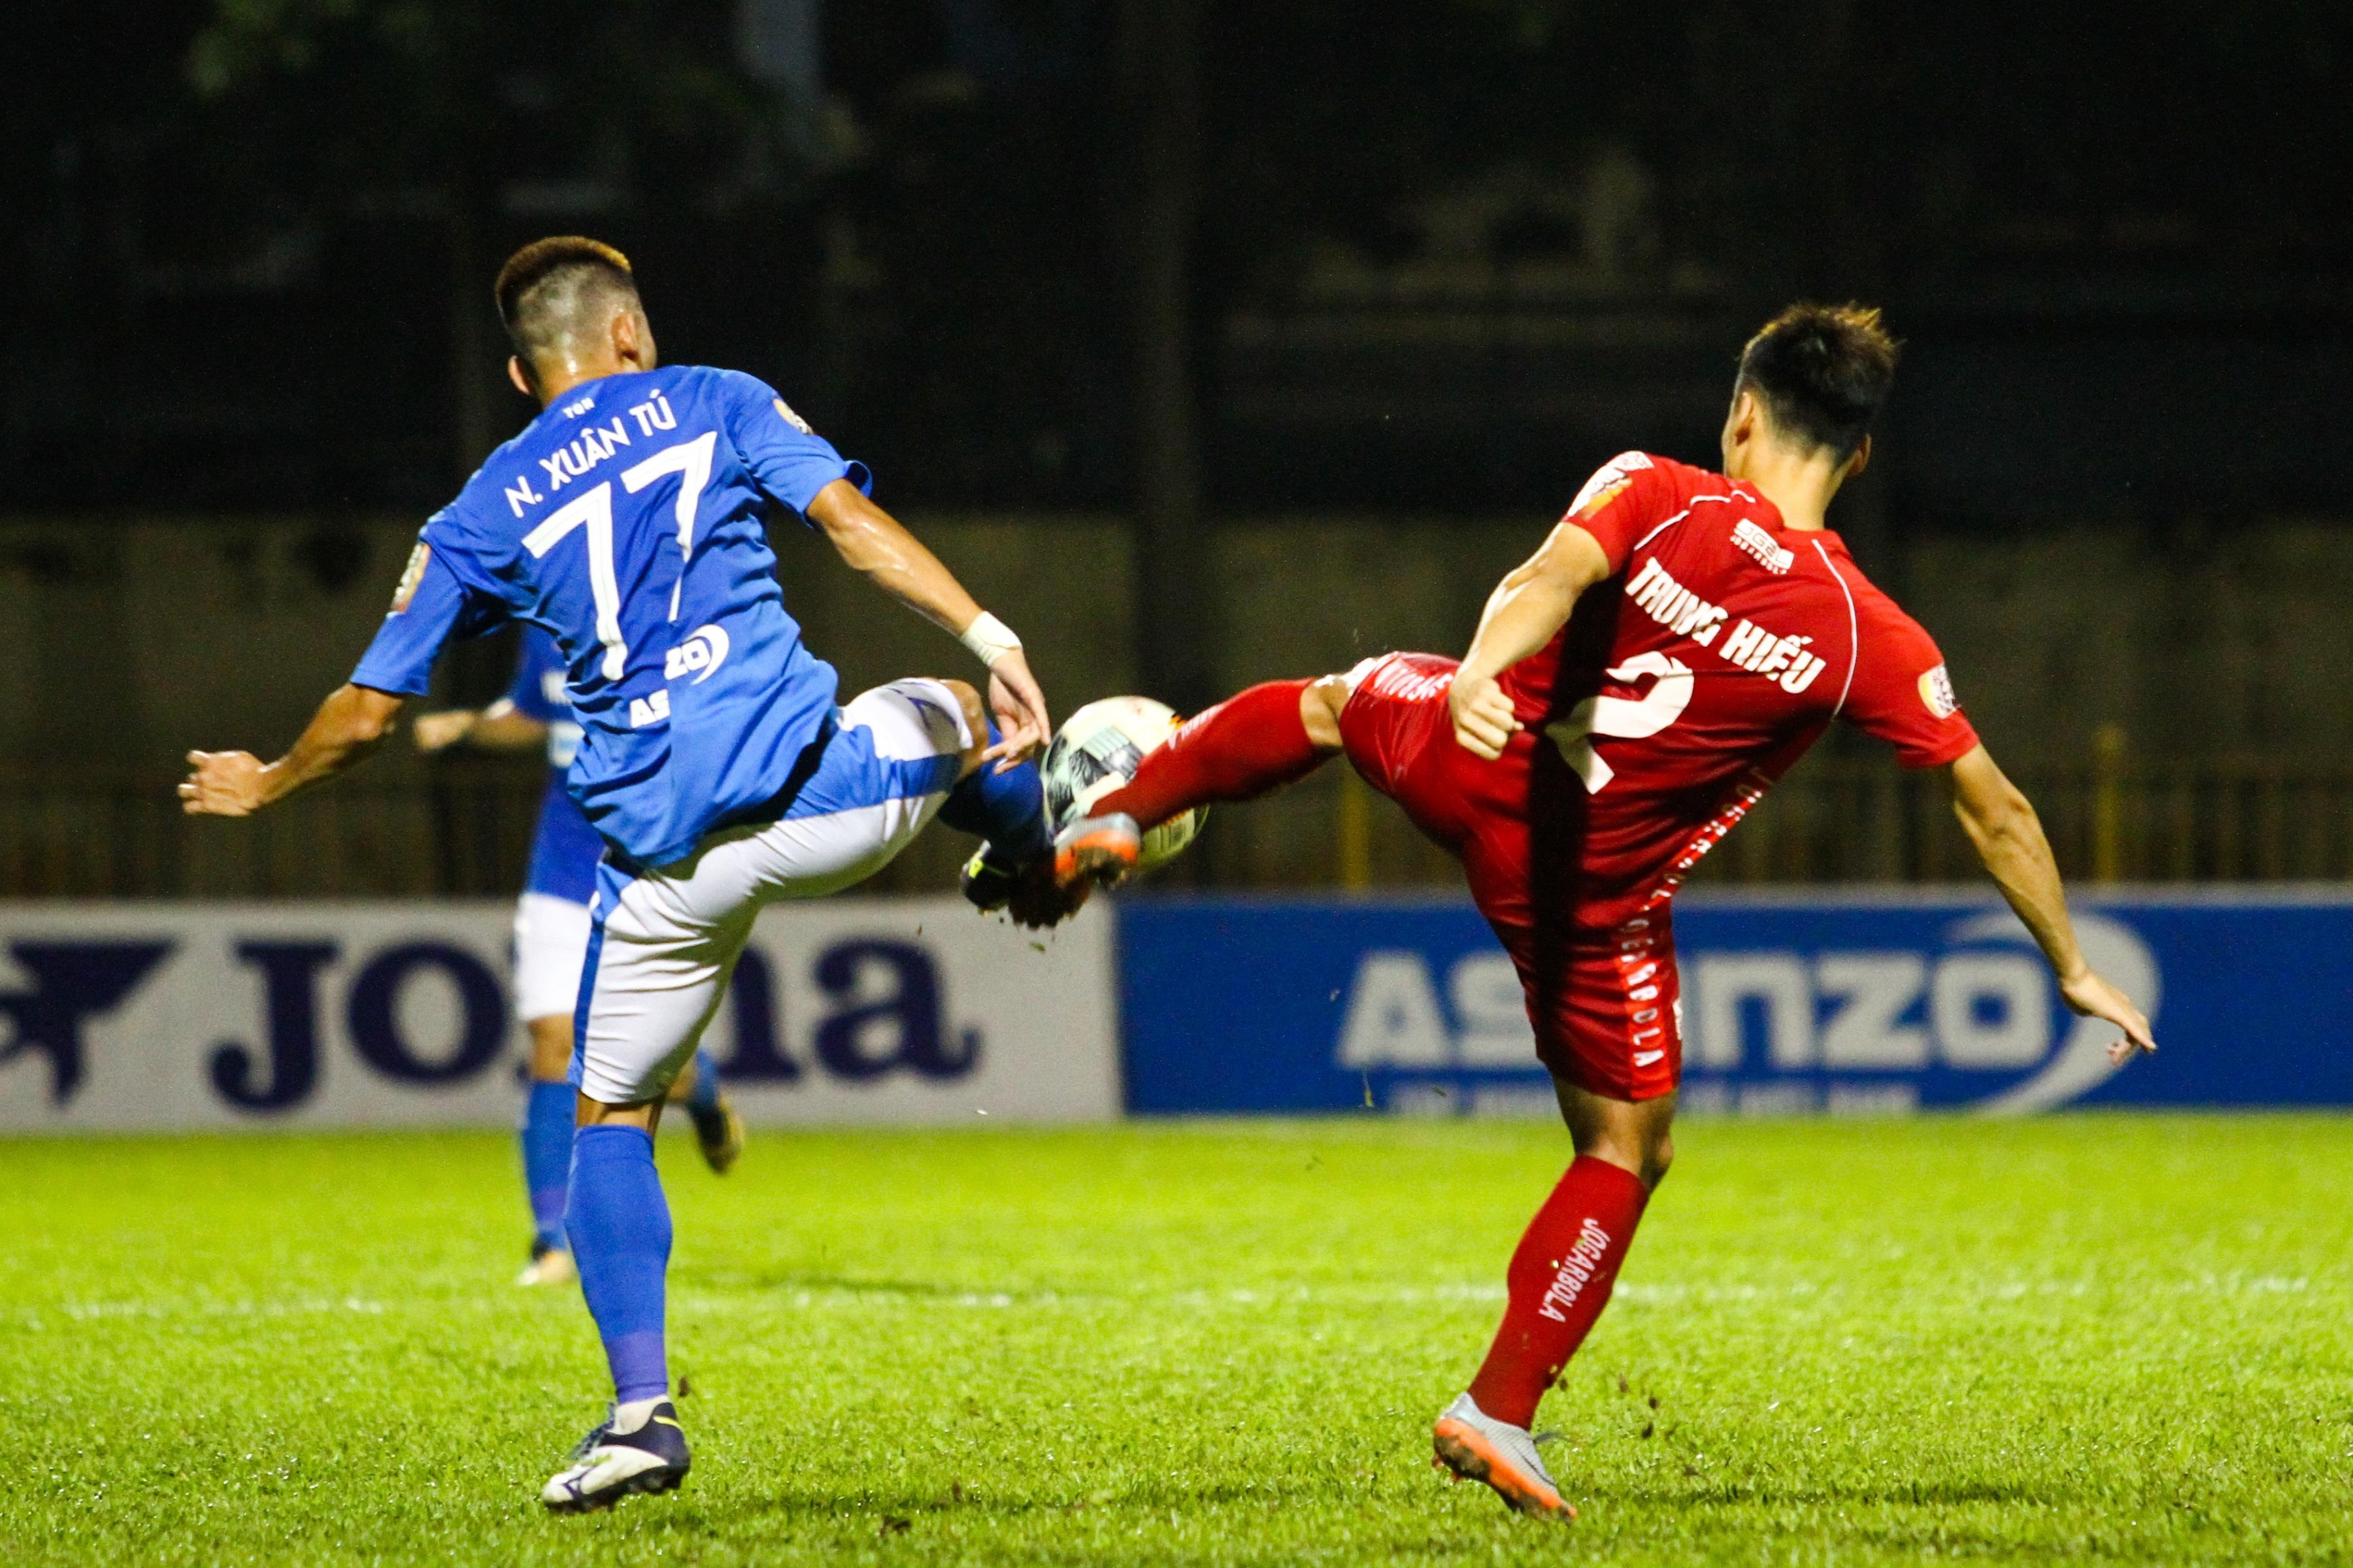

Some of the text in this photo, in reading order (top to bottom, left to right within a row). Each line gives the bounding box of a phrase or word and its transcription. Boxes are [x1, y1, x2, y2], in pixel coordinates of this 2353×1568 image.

[505, 388, 677, 518] N. XUÂN TÚ
[521, 430, 718, 680] 77
[1625, 556, 1827, 694] TRUNG HIẾU
[1545, 650, 1695, 795] 2
[1538, 1218, 1611, 1323] JOGARBOLA
